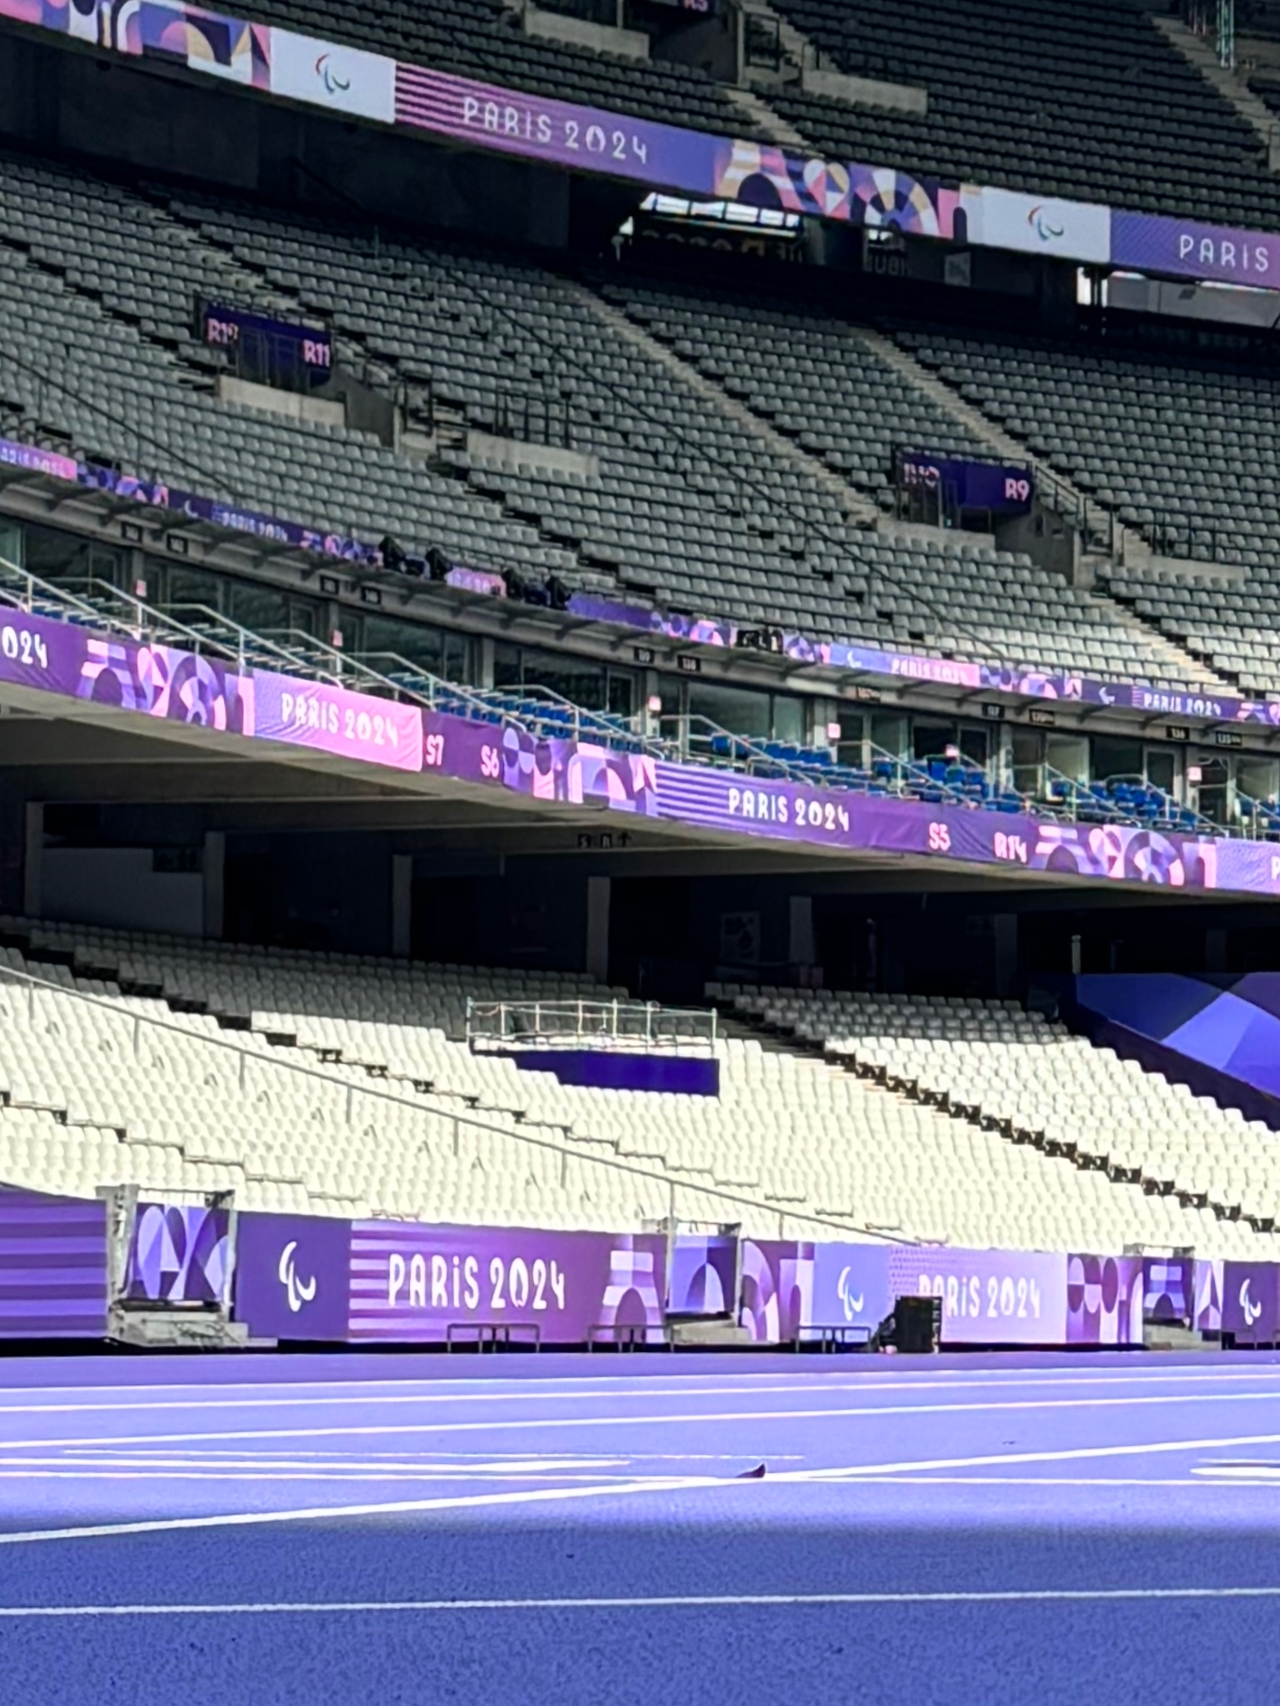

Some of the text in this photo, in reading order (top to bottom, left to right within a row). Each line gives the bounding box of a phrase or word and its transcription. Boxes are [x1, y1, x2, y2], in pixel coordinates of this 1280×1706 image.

[464, 96, 647, 164] PARIS 2024
[1179, 234, 1269, 273] PARIS
[304, 339, 331, 367] R11
[1005, 478, 1030, 502] R9
[2, 625, 48, 669] 024
[281, 692, 398, 748] PARIS 2024
[426, 734, 499, 778] S7 S6
[728, 787, 849, 832] PARIS 2024
[929, 822, 1027, 863] S5 R14
[490, 1256, 565, 1310] 2024
[987, 1275, 1040, 1319] 2024
